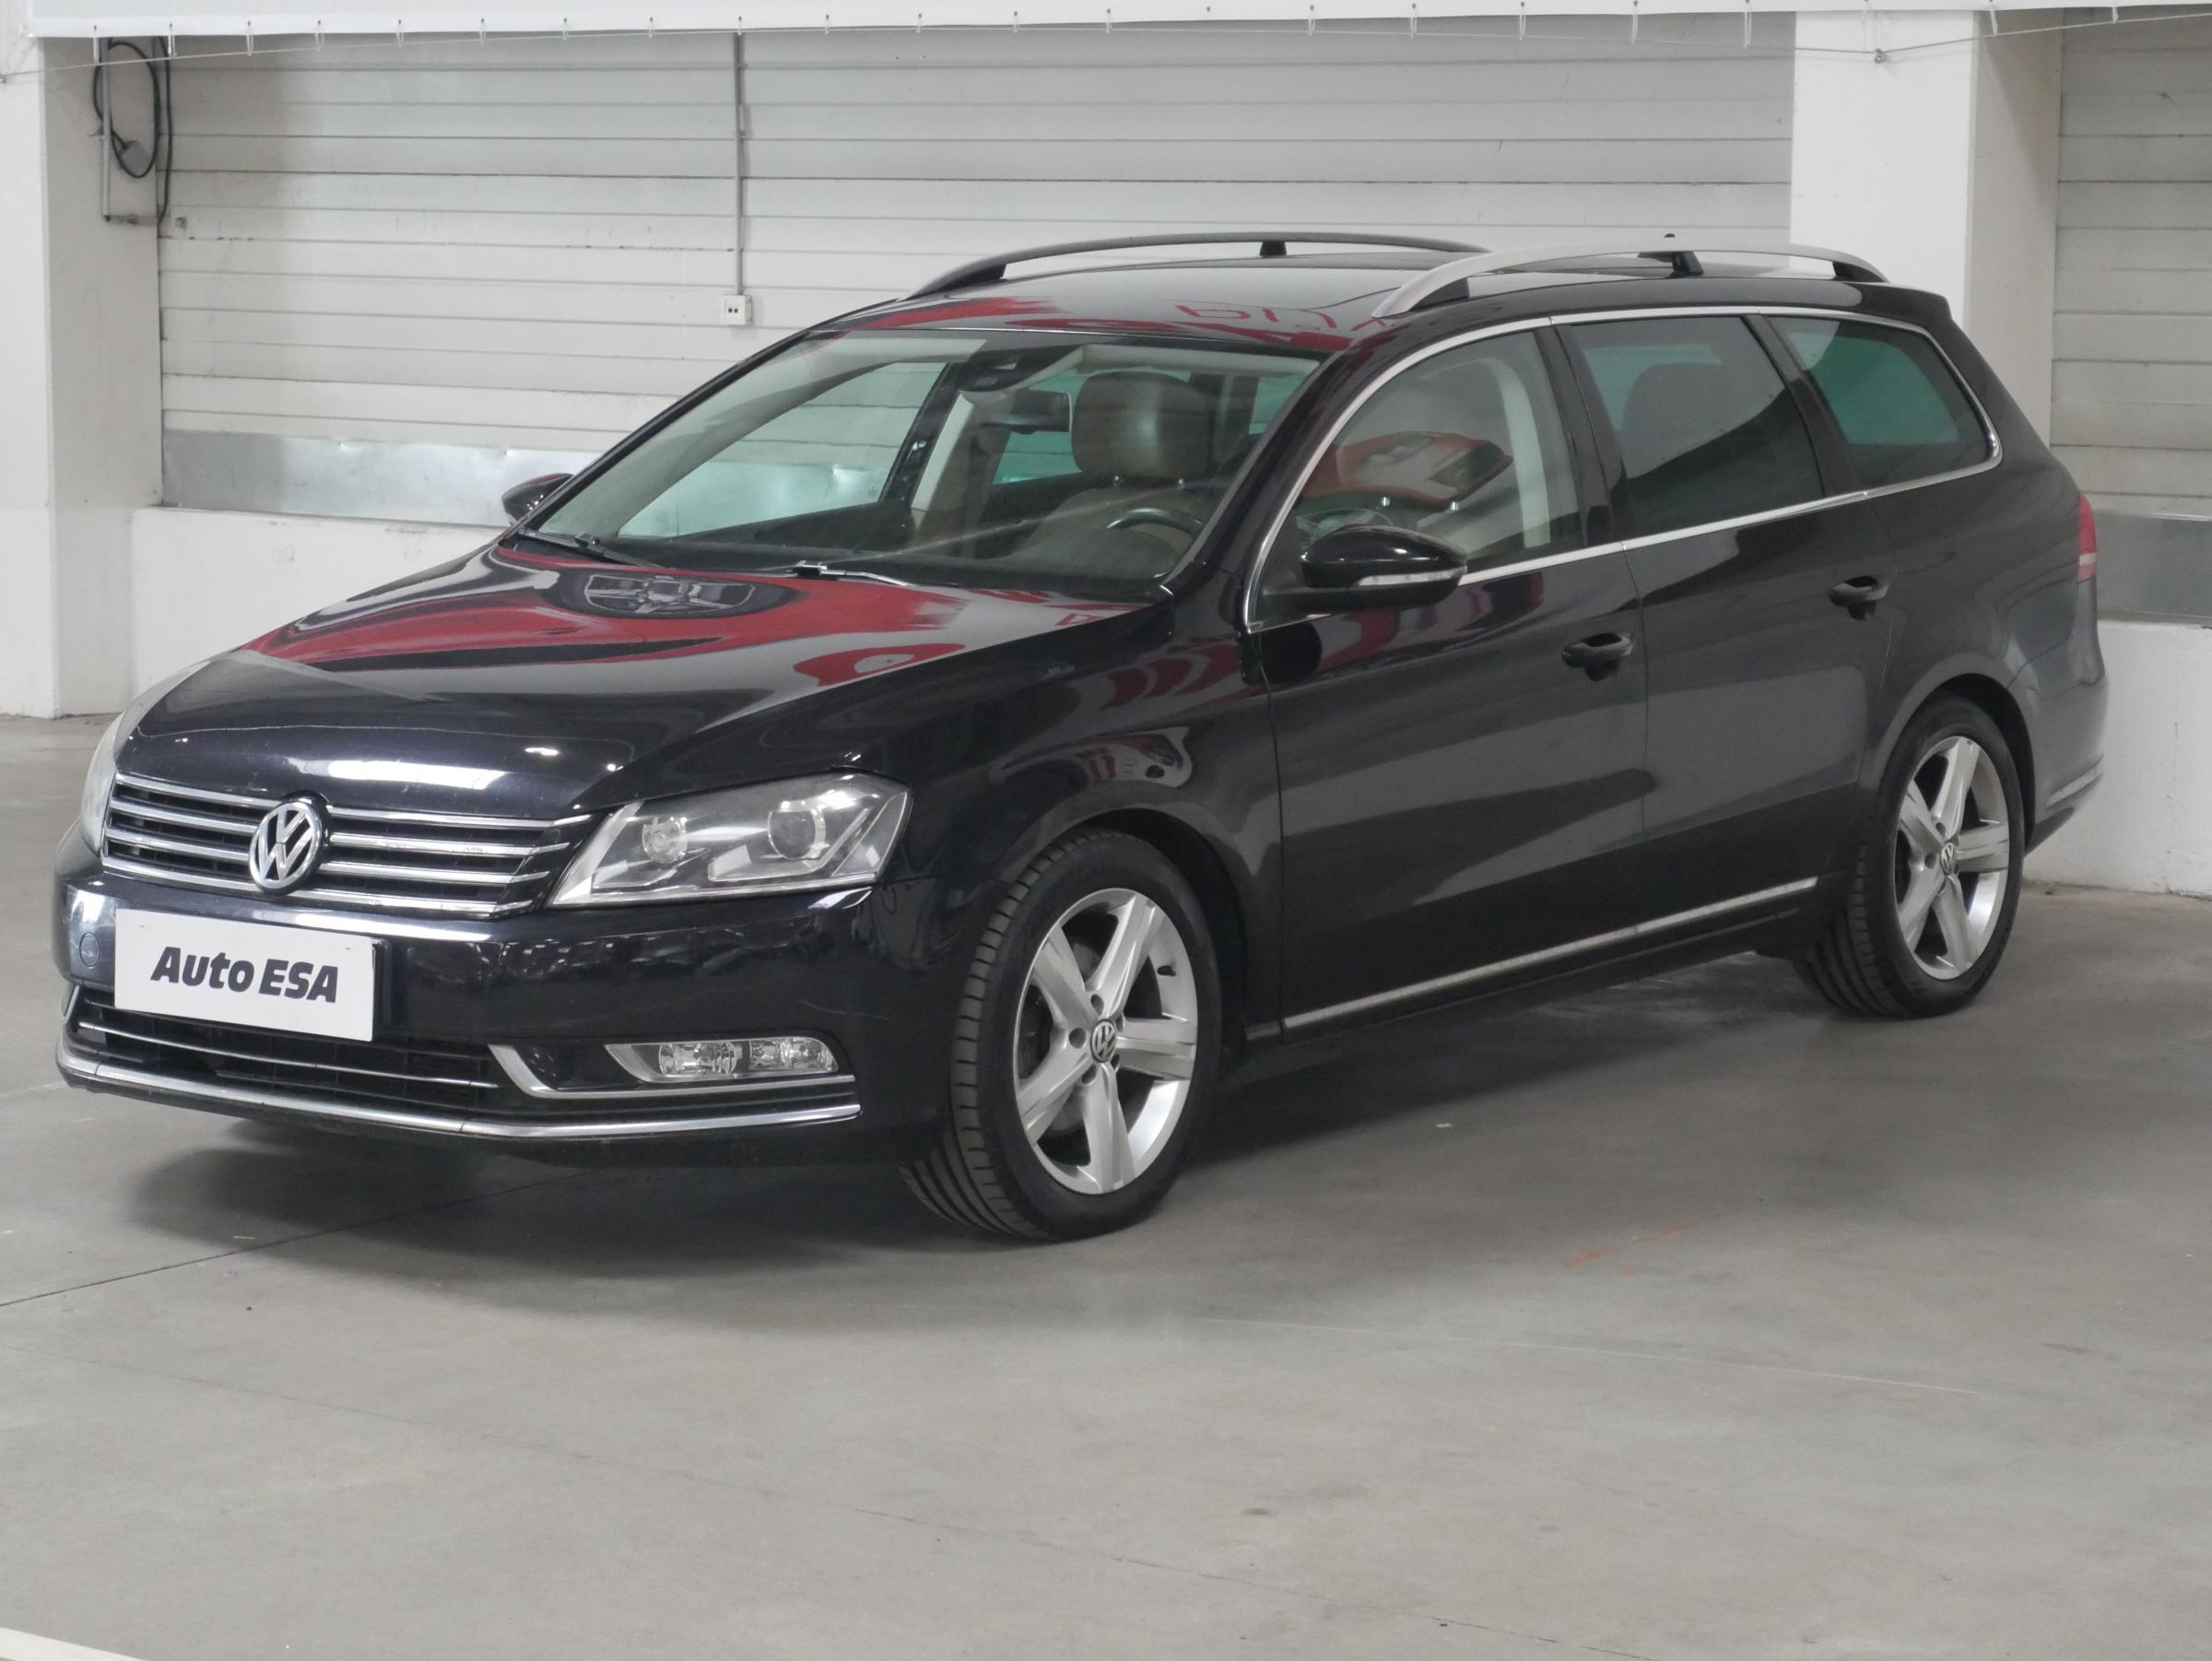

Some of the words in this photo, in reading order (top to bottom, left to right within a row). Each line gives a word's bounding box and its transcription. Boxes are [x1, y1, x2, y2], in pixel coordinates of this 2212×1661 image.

[251, 803, 320, 889] VW
[150, 947, 254, 993] Auto
[258, 959, 338, 1003] ESA
